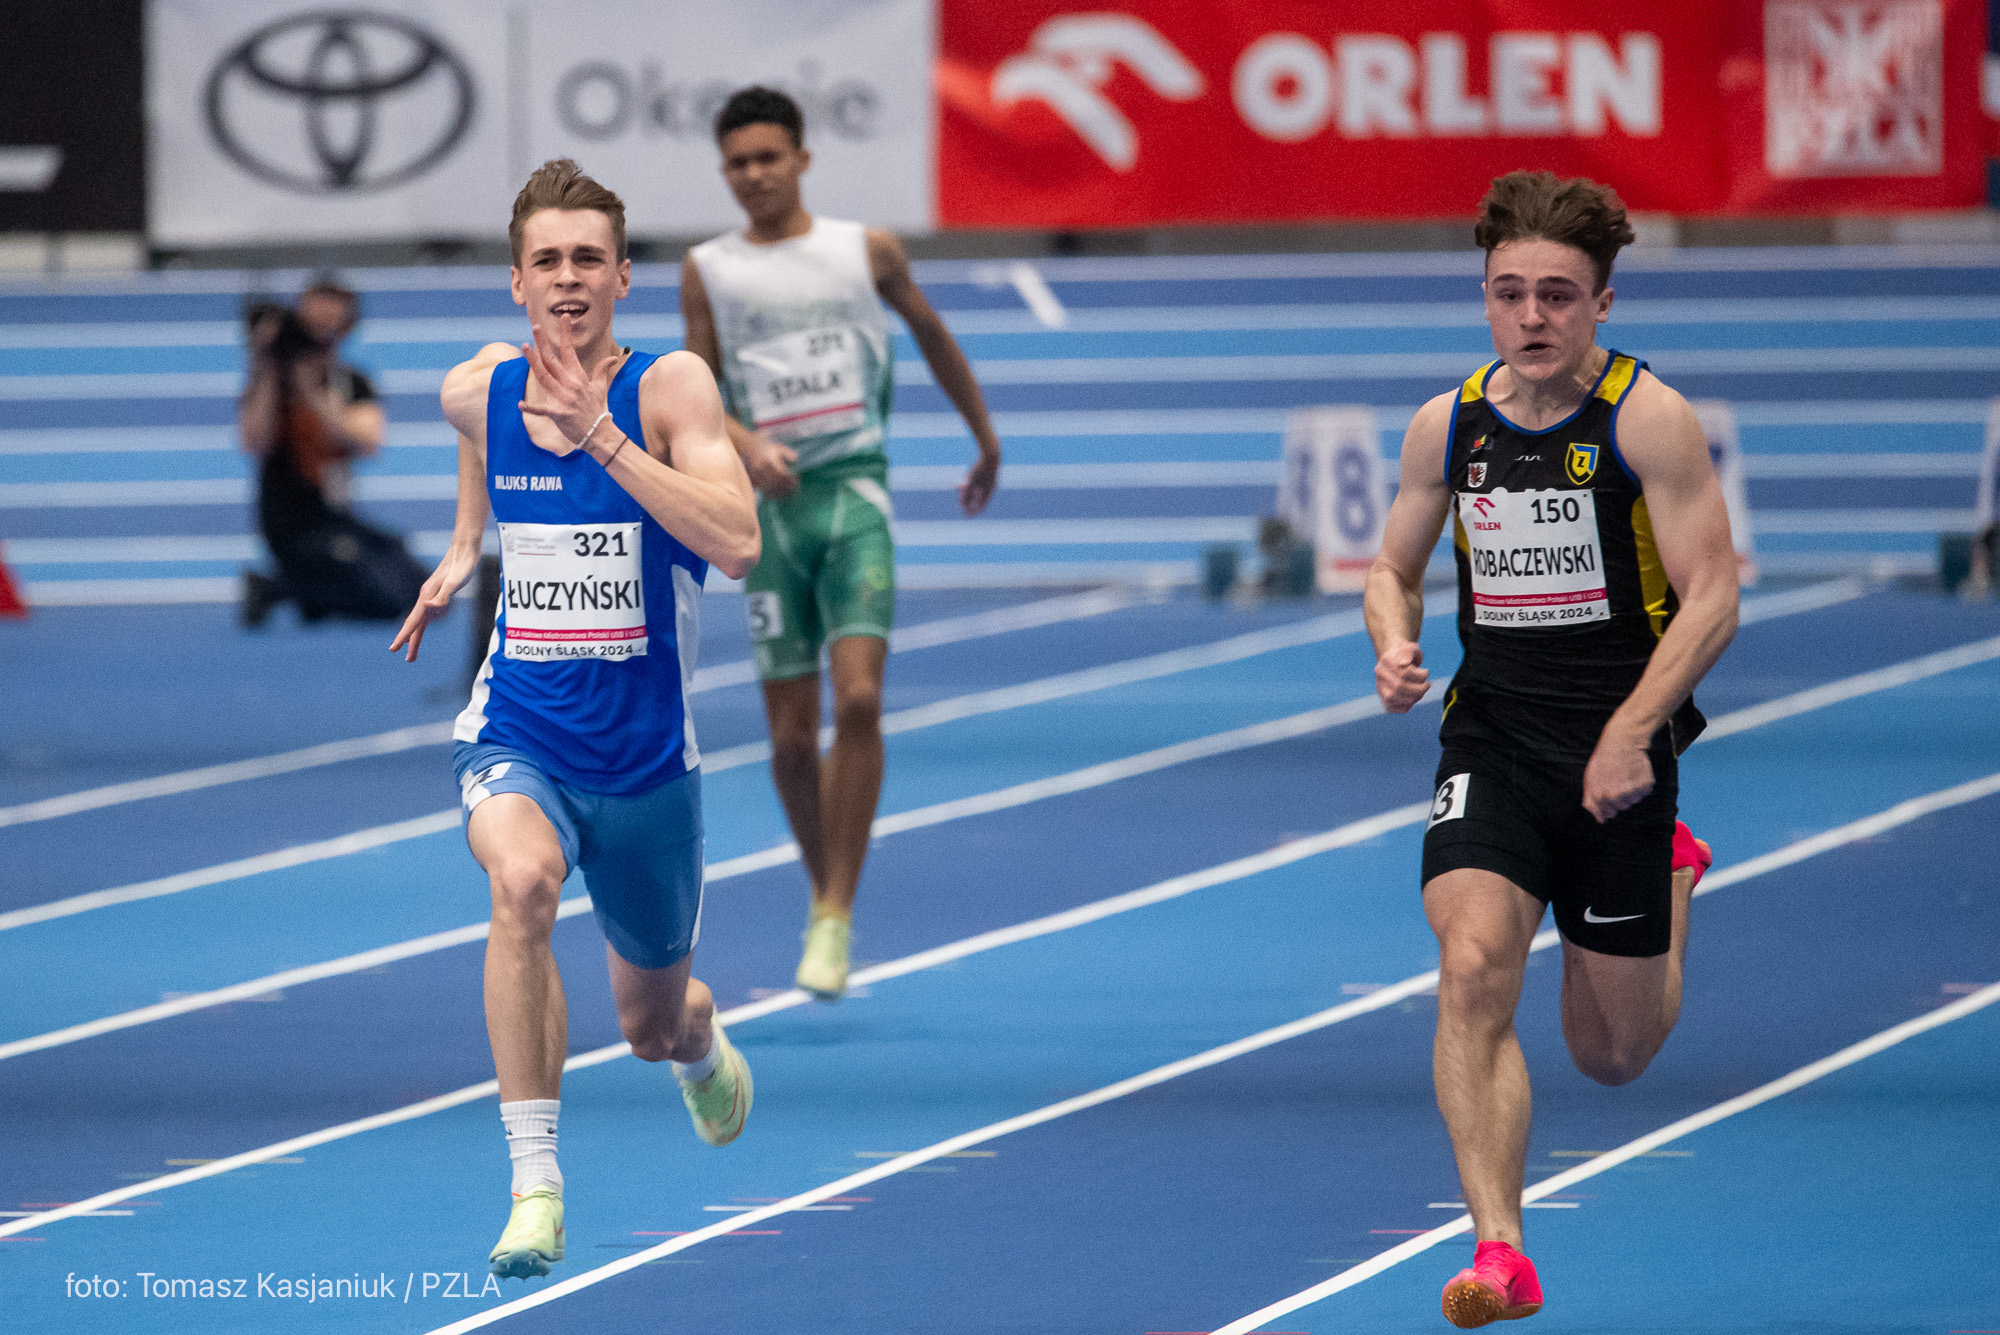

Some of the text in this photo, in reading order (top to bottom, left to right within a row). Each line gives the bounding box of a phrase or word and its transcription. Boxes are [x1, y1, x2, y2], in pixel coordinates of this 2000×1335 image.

[555, 57, 882, 144] Okie
[1231, 31, 1663, 142] ORLEN
[530, 476, 563, 491] RAWA
[1333, 442, 1377, 542] 8
[1530, 497, 1580, 524] 150
[573, 531, 629, 557] 321
[508, 574, 641, 611] ŁUCZYŃSKI
[1483, 606, 1593, 623] DOLNY ŚLĄSK 2024
[515, 644, 633, 658] DOLNY ŚLĄSK 2024
[1432, 781, 1455, 822] 3
